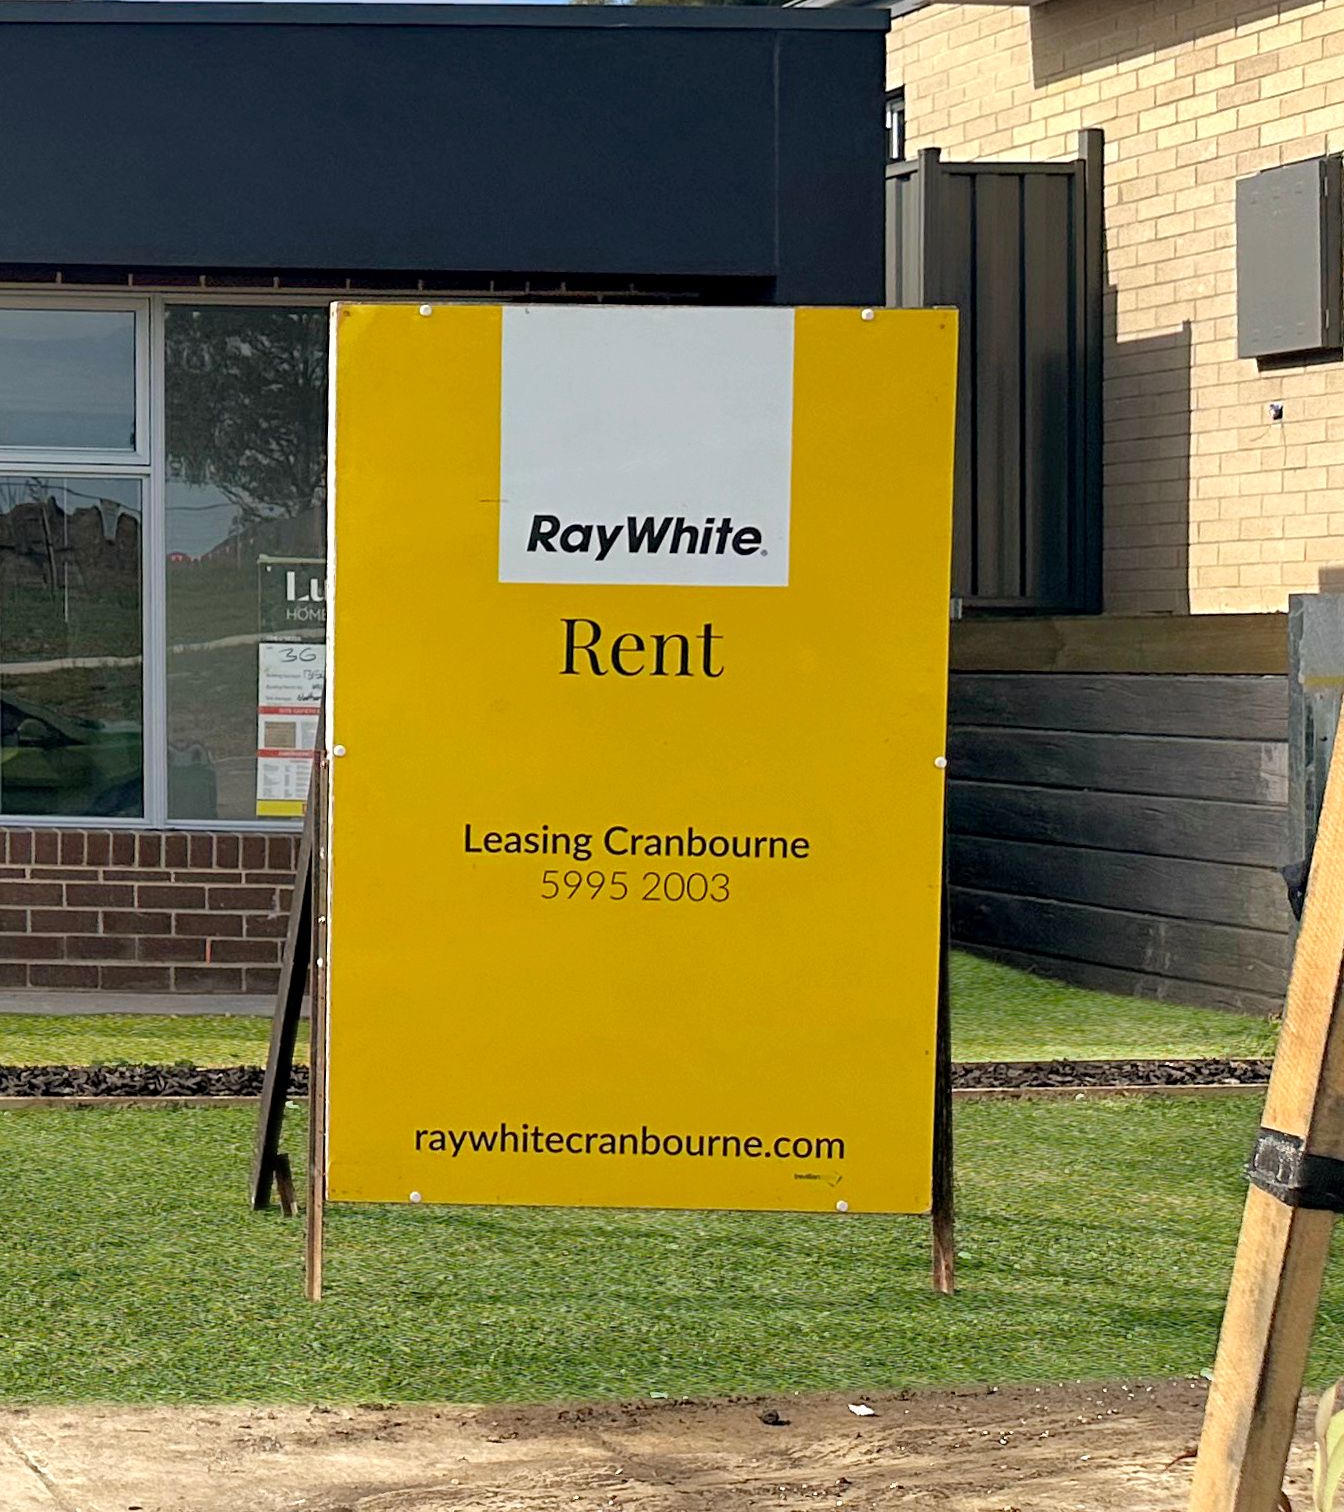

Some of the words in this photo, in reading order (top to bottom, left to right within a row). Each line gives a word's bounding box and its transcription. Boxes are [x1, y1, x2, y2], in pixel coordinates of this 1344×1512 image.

[558, 618, 725, 678] Rent
[464, 823, 593, 862] Leasing
[603, 825, 810, 859] Cranbourne
[540, 869, 629, 901] 5995
[641, 871, 731, 903] 2003
[414, 1122, 846, 1159] raywhitecranbourne.com
